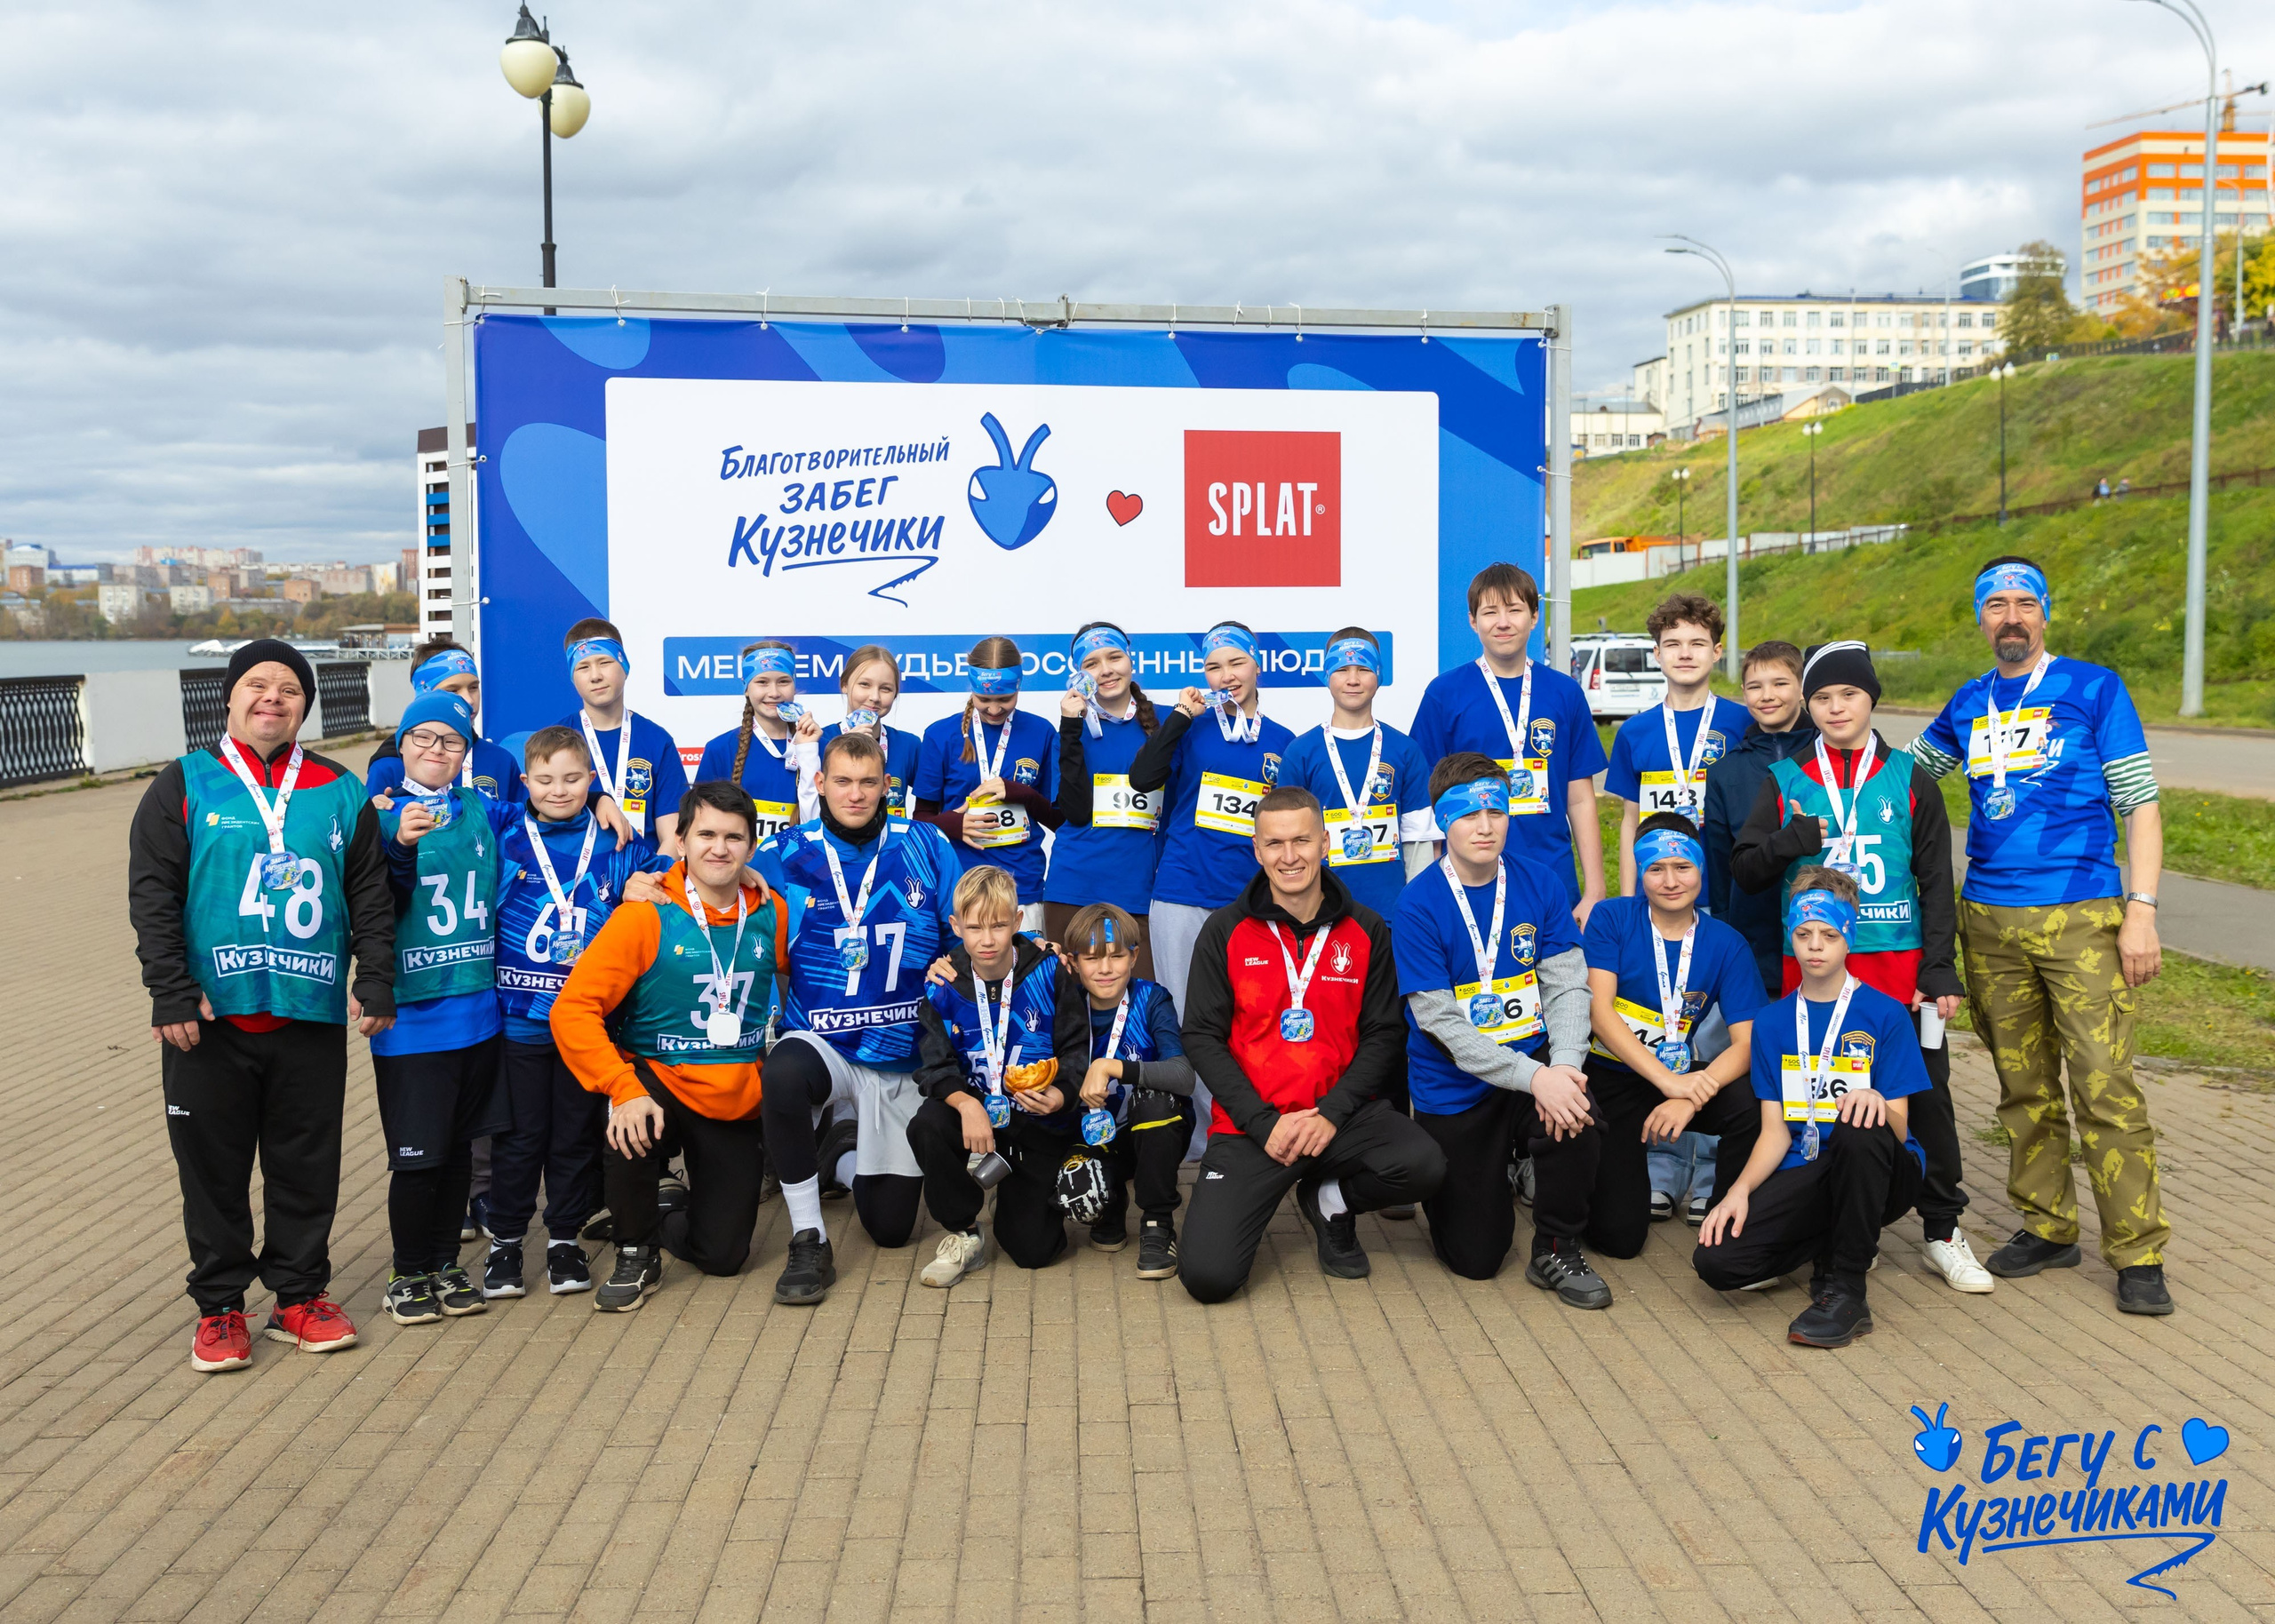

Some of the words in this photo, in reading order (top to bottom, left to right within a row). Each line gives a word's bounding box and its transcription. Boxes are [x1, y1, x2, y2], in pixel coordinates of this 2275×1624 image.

[779, 475, 898, 515] ЗАБЕГ
[1208, 482, 1318, 537] SPLAT
[728, 513, 945, 577] Кузнечики
[1114, 792, 1147, 810] 96
[1213, 793, 1257, 817] 134
[239, 852, 323, 939] 48
[420, 870, 488, 935] 34
[834, 922, 906, 996] 77
[690, 971, 755, 1029] 37
[814, 1004, 919, 1031] КУЗНЕЧИК
